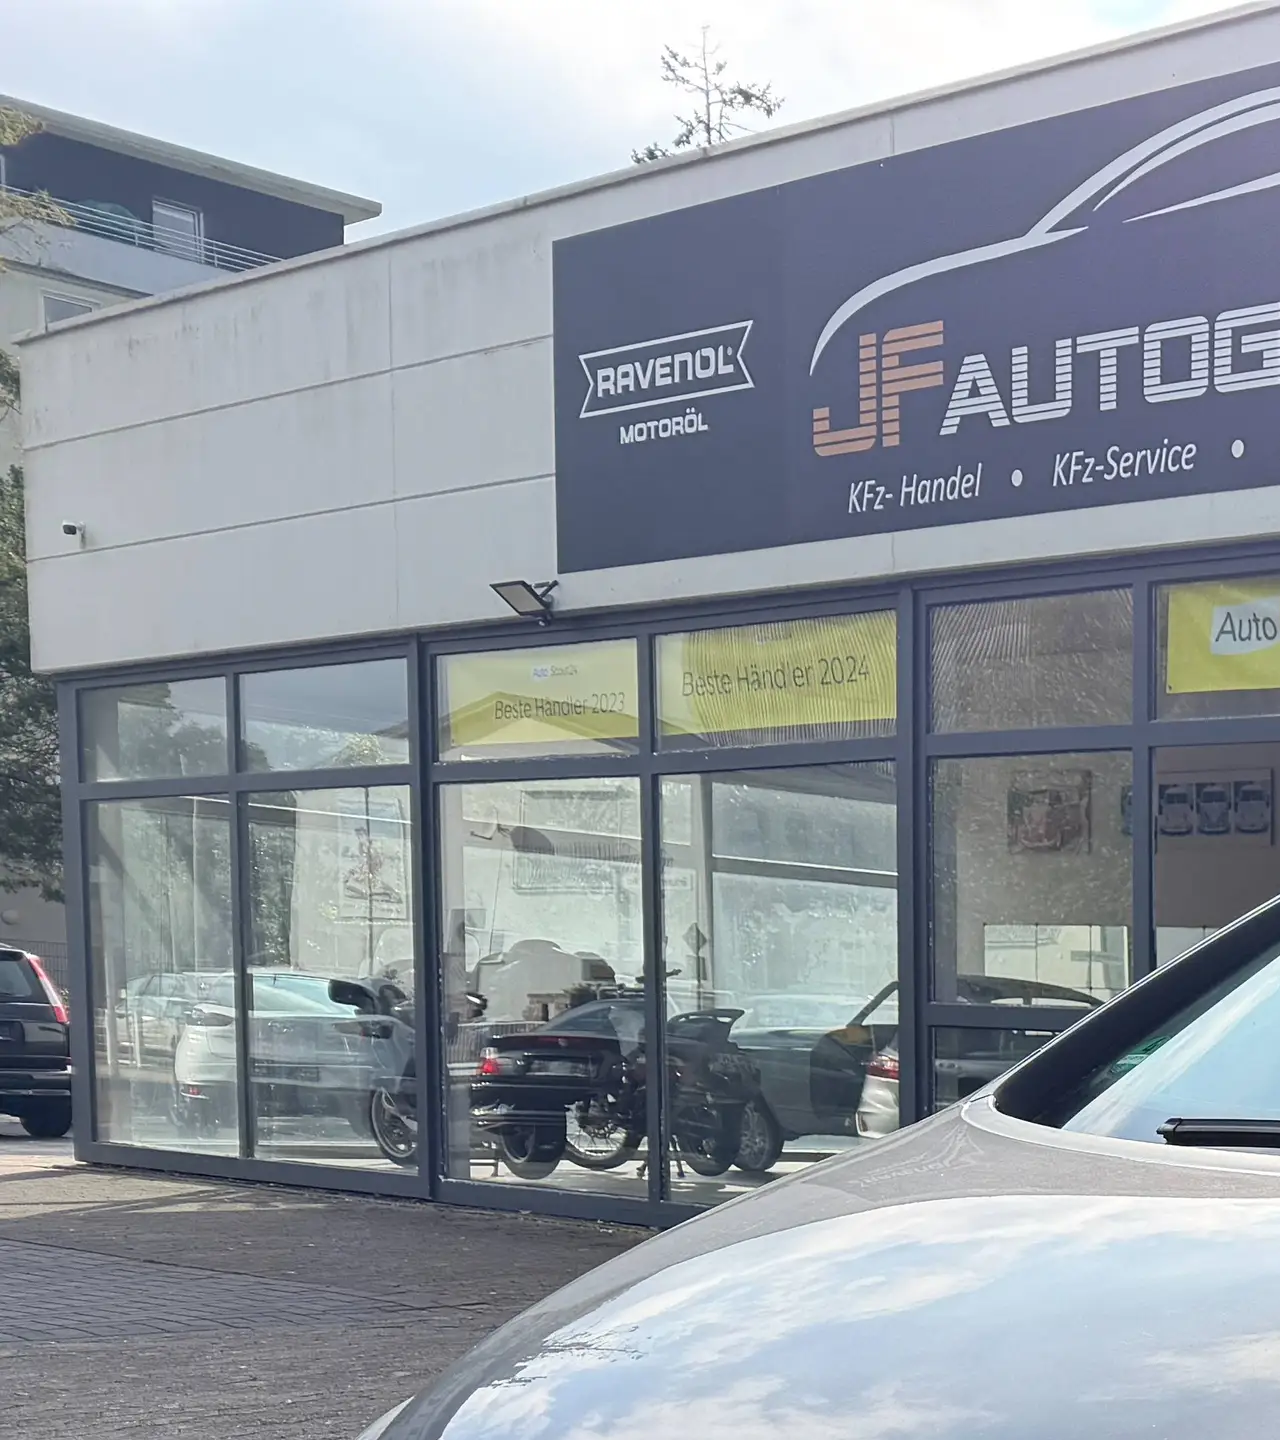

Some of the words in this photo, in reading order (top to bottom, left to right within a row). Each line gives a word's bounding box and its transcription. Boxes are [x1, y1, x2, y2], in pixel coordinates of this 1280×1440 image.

[812, 320, 945, 457] JF
[619, 407, 709, 444] MOTORÖL
[900, 462, 983, 507] Handel
[1052, 438, 1197, 487] KFz-Service
[1215, 611, 1278, 642] Auto
[682, 670, 733, 697] Beste
[818, 654, 868, 686] 2024
[494, 700, 532, 719] Beste
[592, 691, 625, 714] 2023
